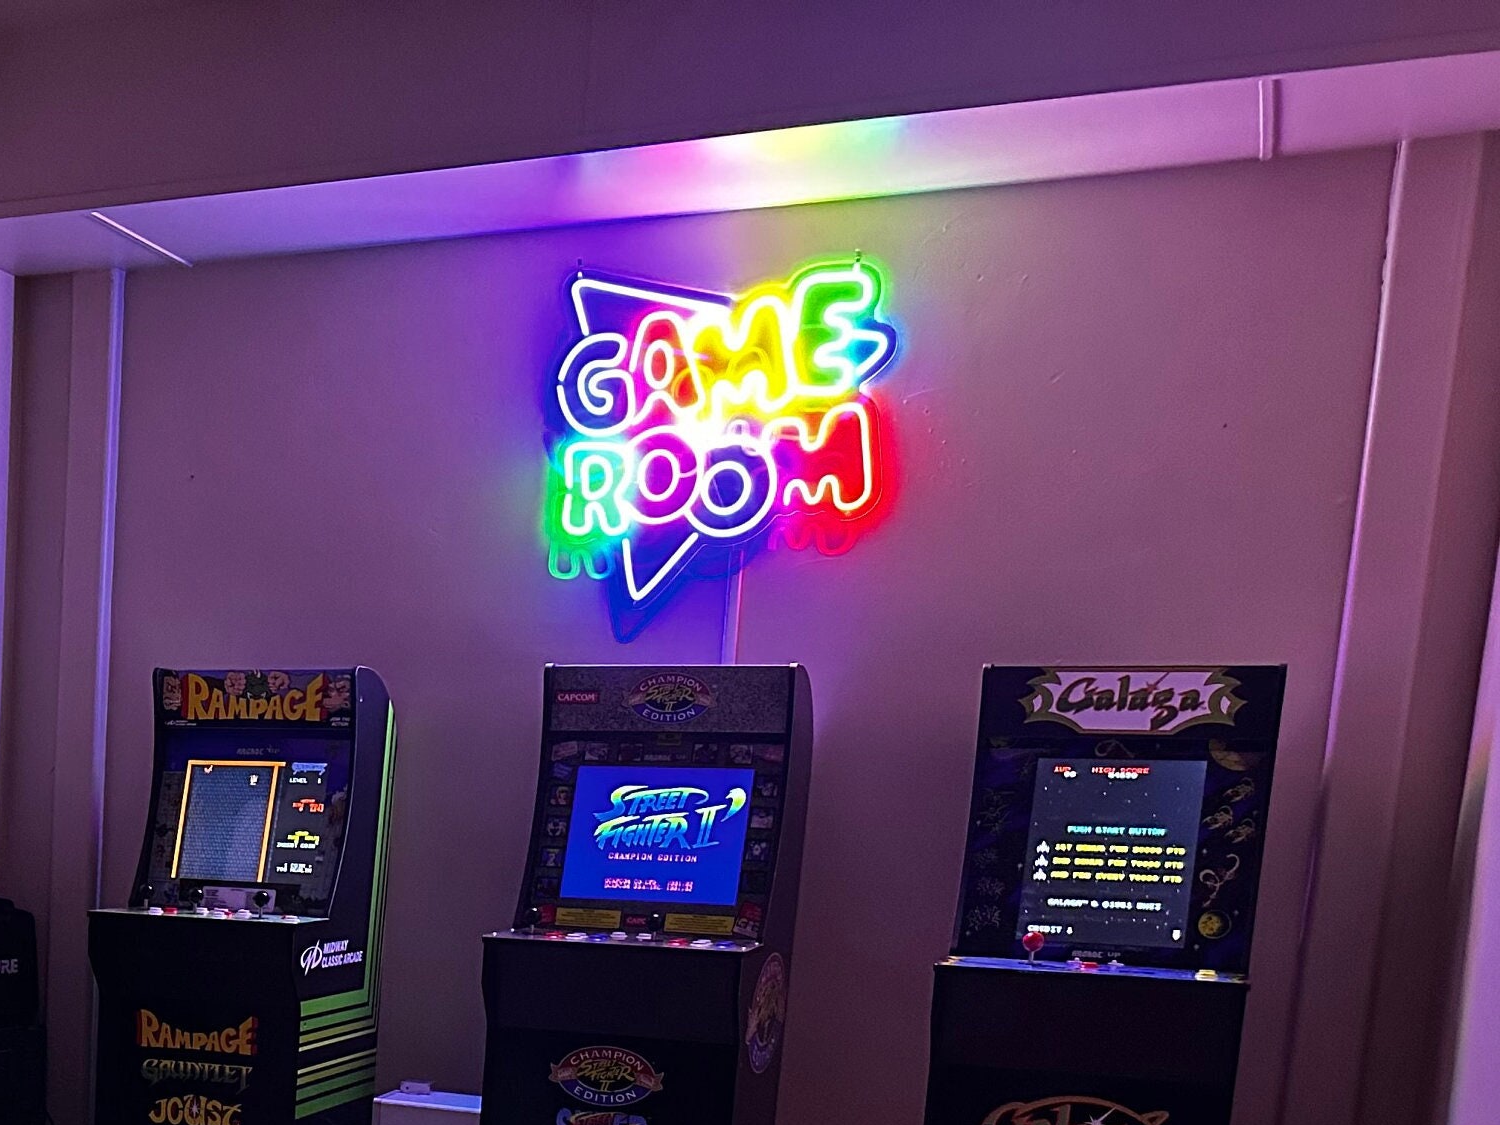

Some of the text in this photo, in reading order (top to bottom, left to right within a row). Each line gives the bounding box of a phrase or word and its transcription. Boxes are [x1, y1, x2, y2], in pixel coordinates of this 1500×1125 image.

[556, 268, 888, 437] GAME
[562, 402, 874, 538] ROOM
[639, 675, 703, 692] CHAMPION
[185, 672, 325, 722] RAMPAGE
[557, 693, 597, 702] CAPCOM
[1056, 675, 1206, 732] Galaga
[642, 708, 696, 722] EDITION
[592, 785, 709, 822] STREET
[593, 812, 691, 850] FIGHTER
[1067, 825, 1167, 837] PUSH START BUTTON
[608, 852, 698, 863] CHAMPION EDITION
[1027, 924, 1063, 934] CREDIT
[323, 940, 349, 955] MIDWAY
[321, 950, 364, 969] CLASSIC ARCADE
[138, 1008, 258, 1056] RAMPAGE
[570, 1049, 645, 1072] CHAMPION
[141, 1058, 253, 1094] GAUNTLET
[573, 1086, 637, 1103] EDITION
